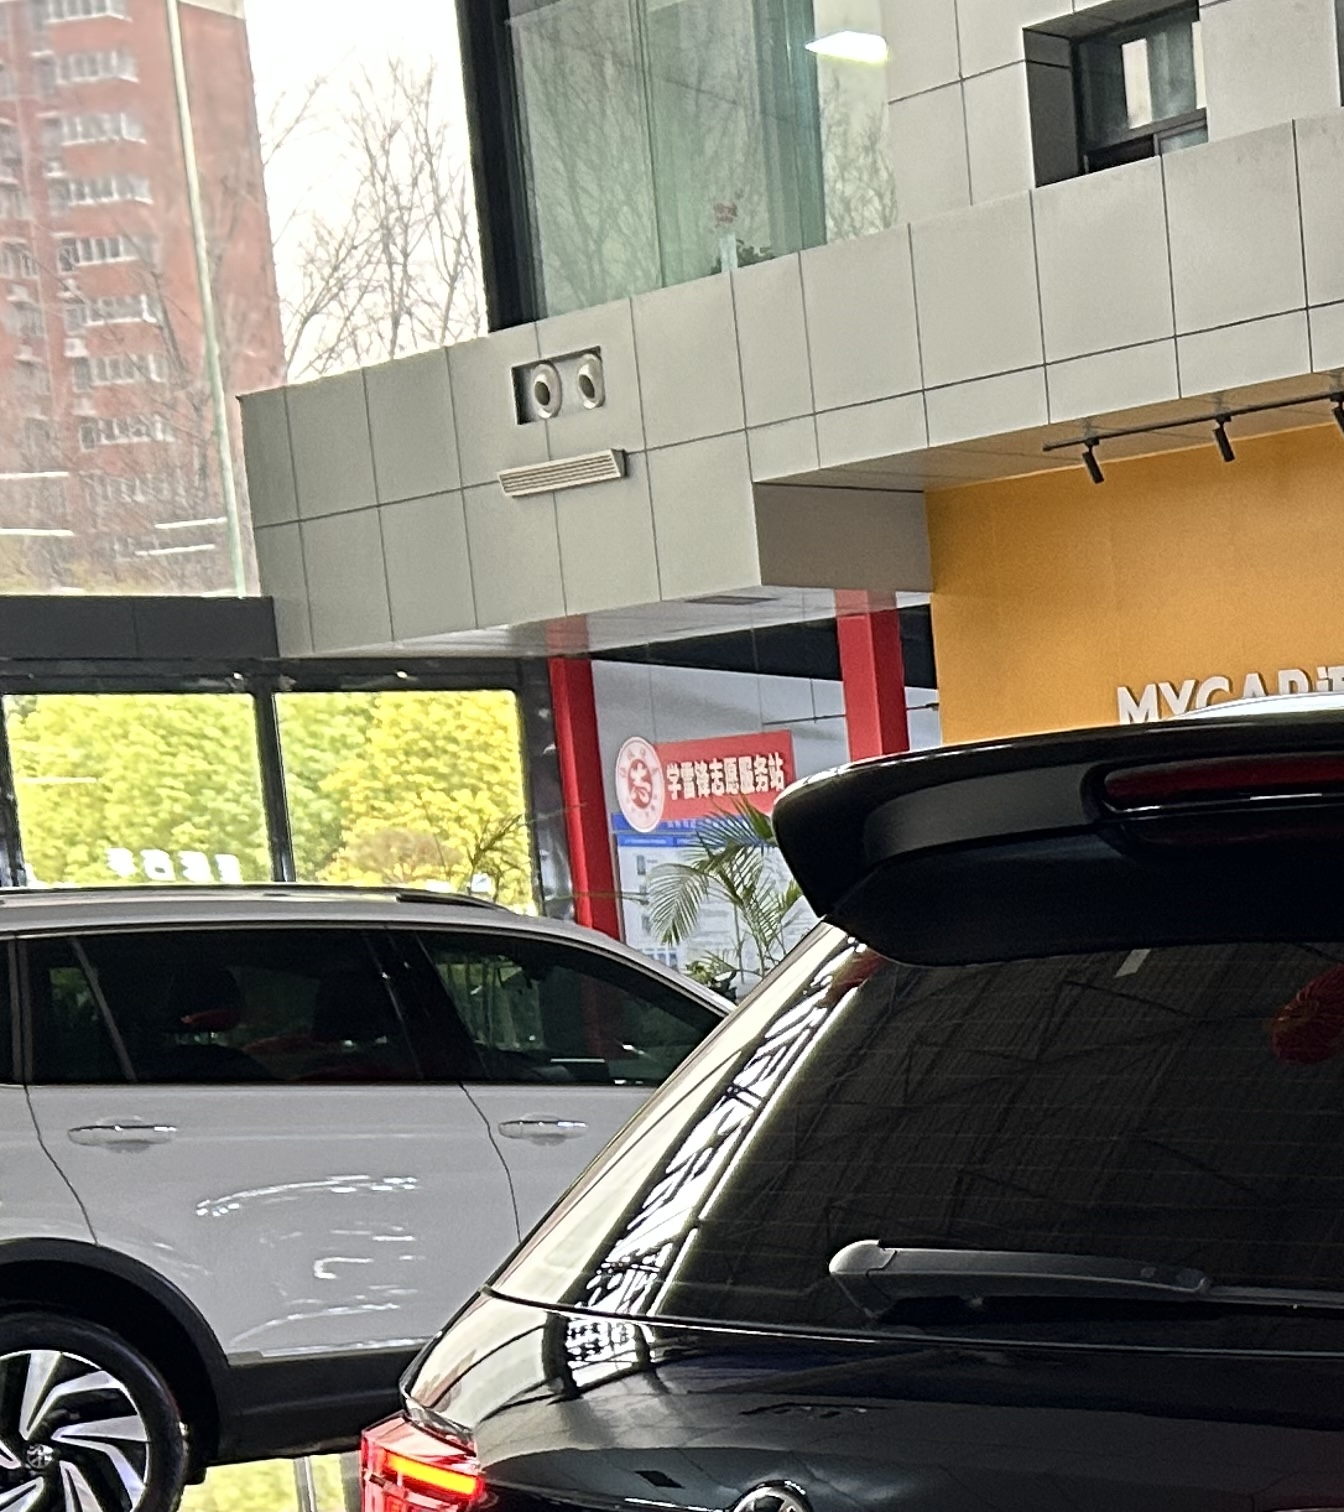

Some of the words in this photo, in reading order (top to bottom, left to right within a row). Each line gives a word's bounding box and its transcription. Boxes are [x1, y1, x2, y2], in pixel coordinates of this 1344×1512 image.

[666, 752, 785, 800] 学雷锋志愿服务站
